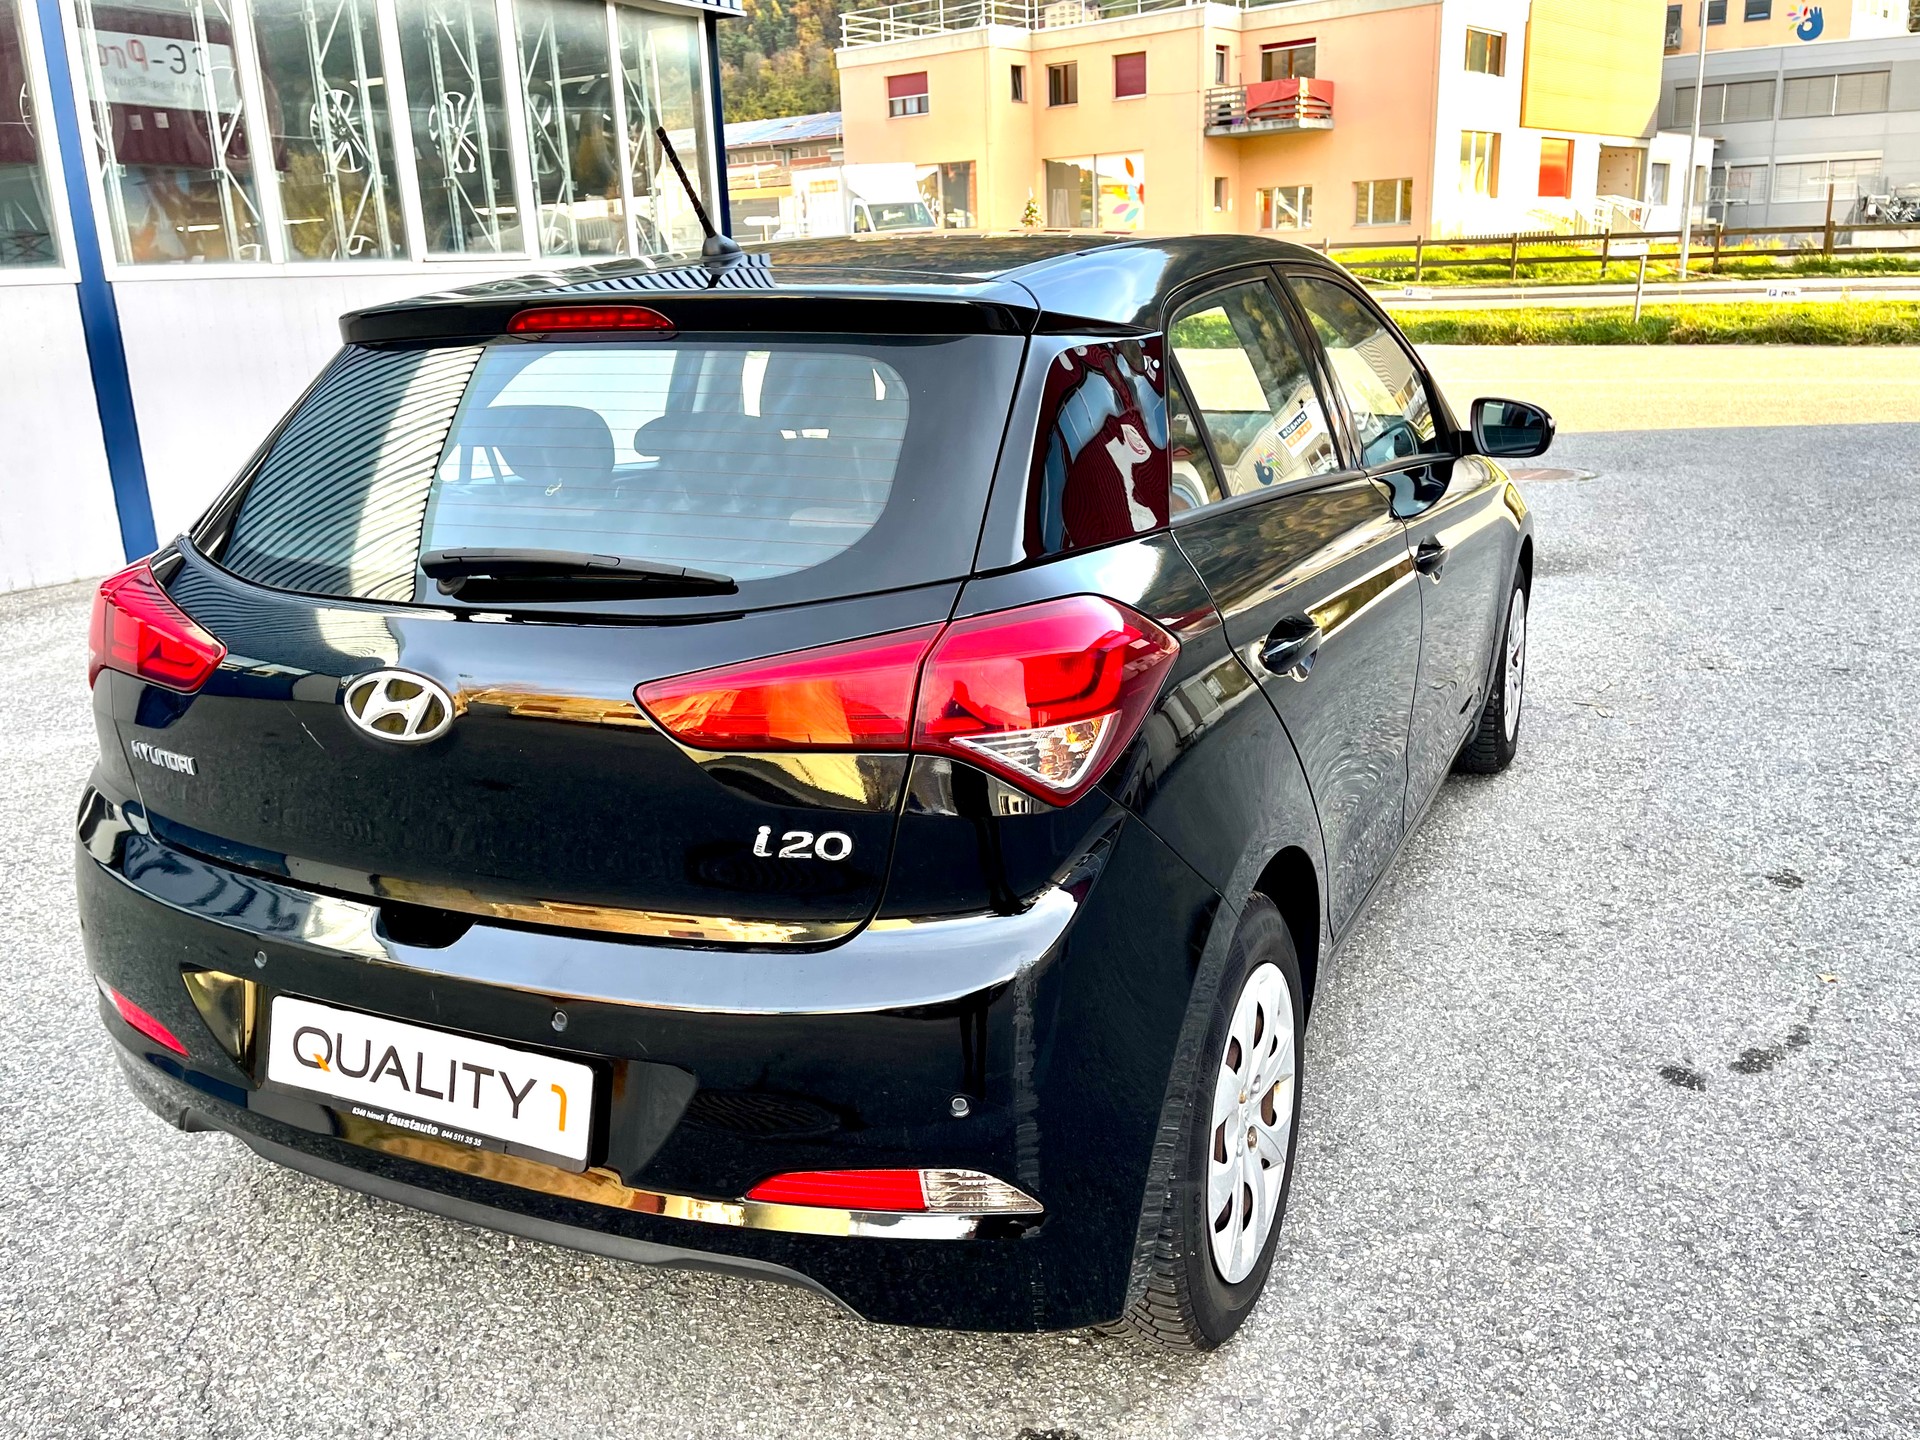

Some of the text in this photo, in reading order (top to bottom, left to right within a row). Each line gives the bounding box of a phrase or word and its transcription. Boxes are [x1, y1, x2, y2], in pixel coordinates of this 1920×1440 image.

[131, 740, 196, 775] HYUNDAI
[752, 825, 853, 861] i20
[293, 1025, 537, 1119] QUALITY
[386, 1113, 438, 1136] faustauto
[441, 1130, 453, 1139] 044
[453, 1132, 464, 1142] 511
[464, 1136, 473, 1144] 35
[474, 1137, 482, 1147] 35
